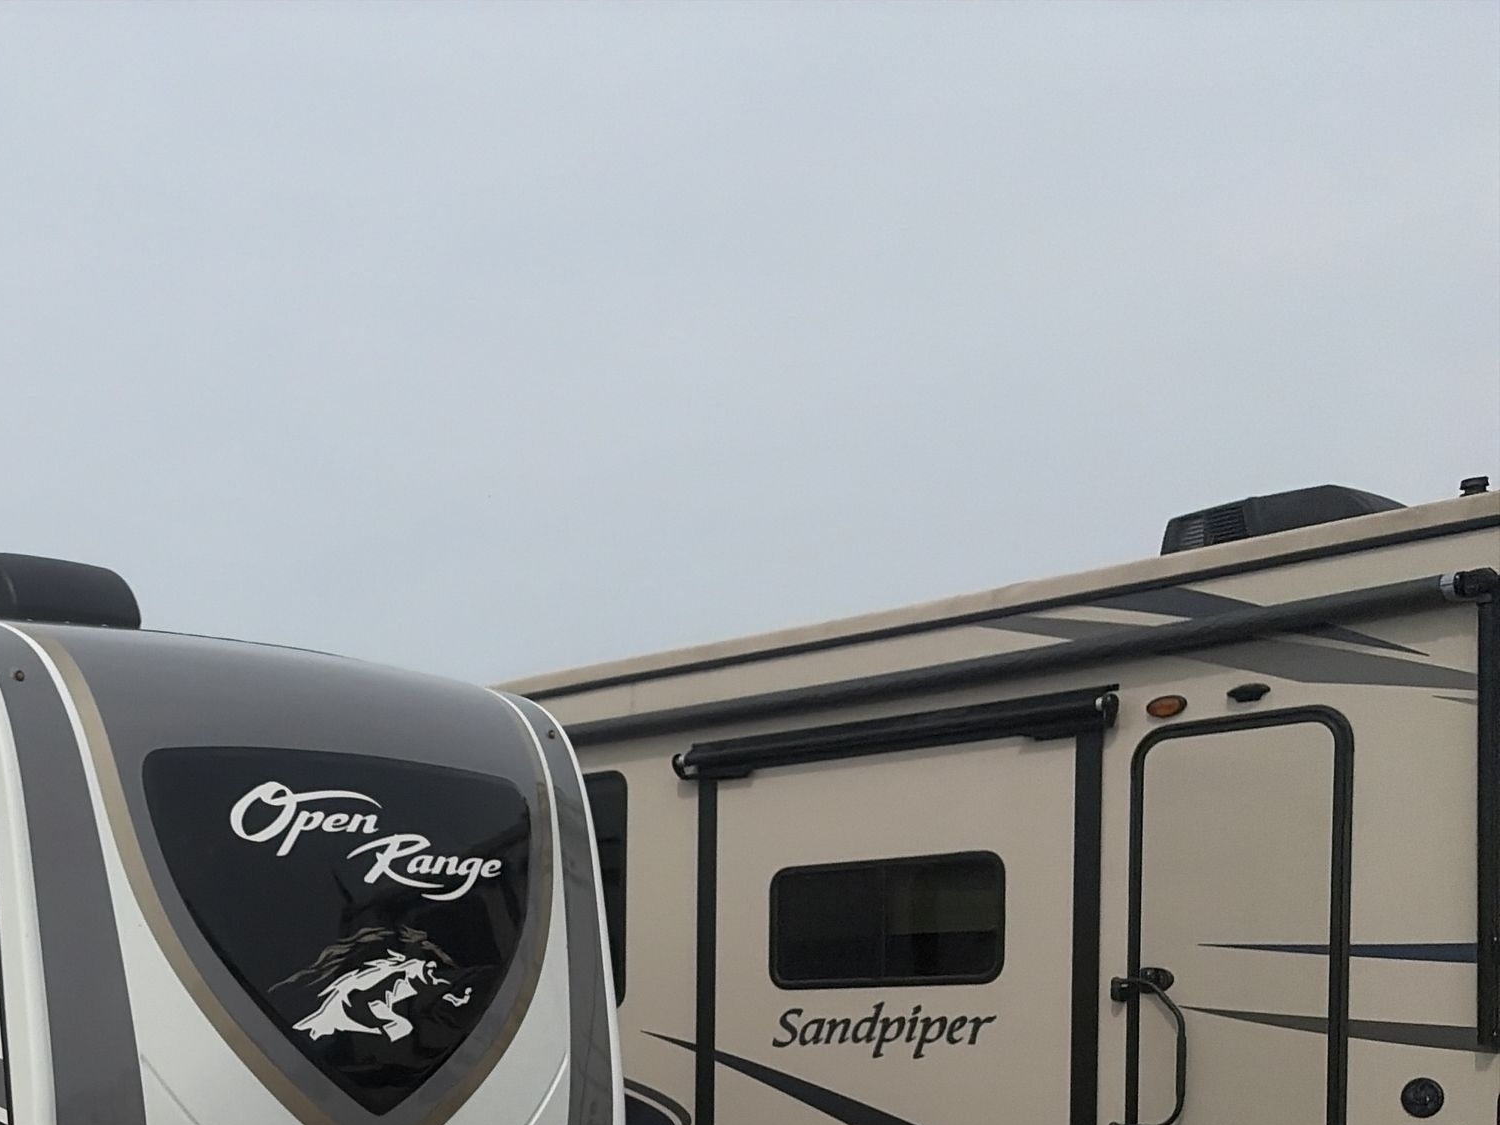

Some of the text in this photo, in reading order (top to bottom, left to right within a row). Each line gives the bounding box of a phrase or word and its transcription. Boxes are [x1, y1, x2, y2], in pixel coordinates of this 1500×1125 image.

[230, 781, 382, 856] Open
[347, 834, 501, 900] Range
[772, 1001, 997, 1059] Sandpiper
